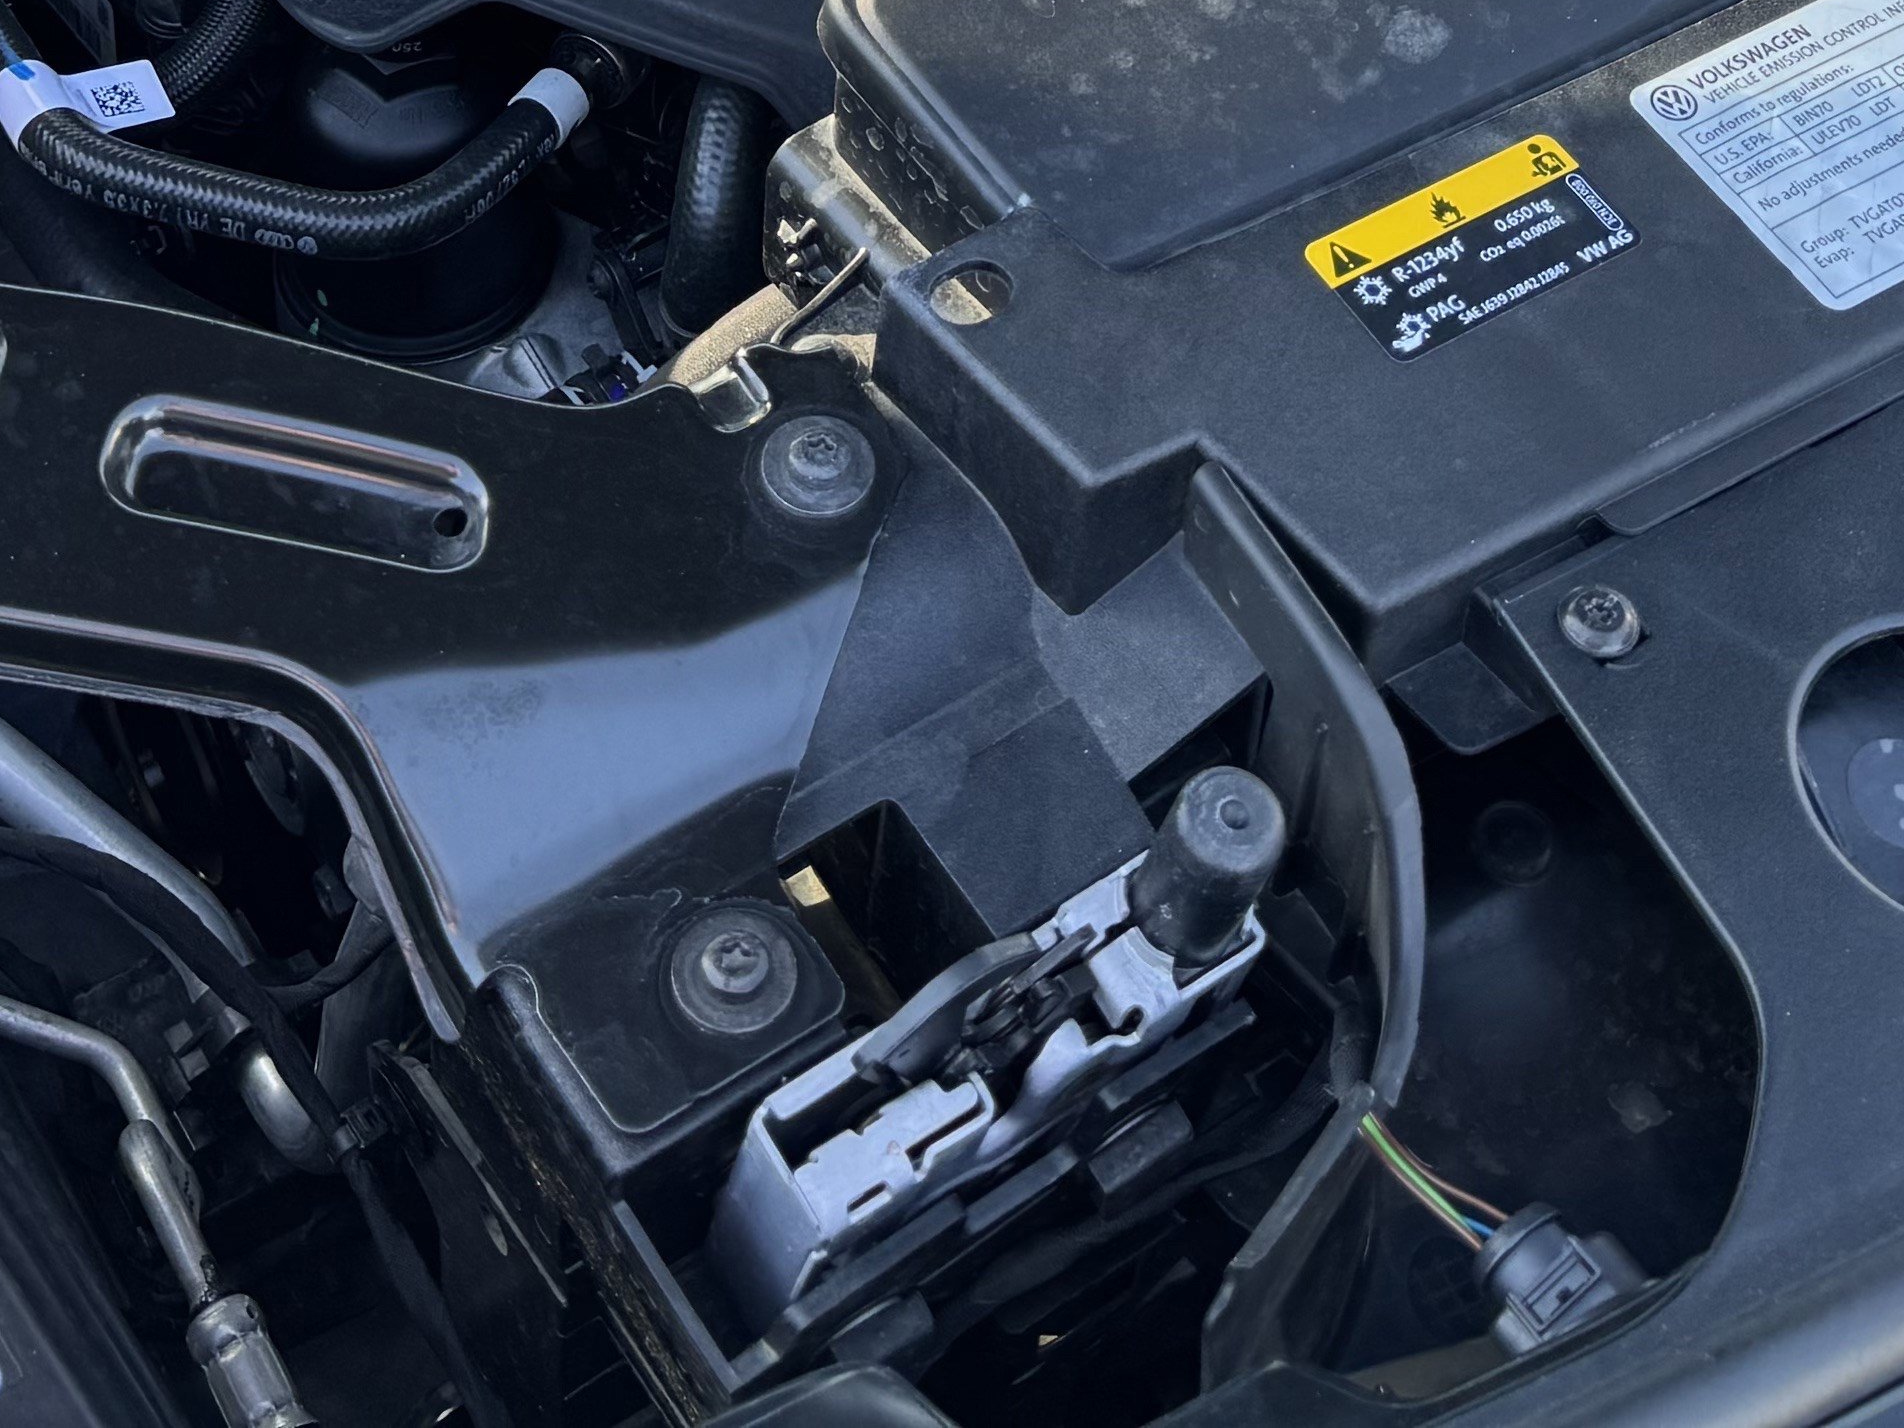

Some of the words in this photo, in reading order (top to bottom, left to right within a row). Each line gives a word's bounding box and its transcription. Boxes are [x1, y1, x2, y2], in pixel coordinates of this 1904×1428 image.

[1686, 23, 1812, 90] VOLKSWAGEN
[1702, 70, 1761, 105] VEHICLE
[1757, 40, 1825, 78] EMISSION
[1822, 12, 1886, 47] CONTROL
[1850, 75, 1887, 98] LDT2
[1694, 107, 1761, 145] Conforms
[1776, 64, 1855, 107] regulations:
[1792, 100, 1834, 127] BIN70
[1868, 96, 1896, 117] LDT
[1810, 114, 1862, 145] ULEV70
[1713, 146, 1745, 166] U.S.
[1740, 132, 1775, 152] EPA:
[1732, 146, 1804, 184] California:
[1757, 196, 1781, 212] No
[1780, 153, 1864, 201] adjustments
[1493, 205, 1534, 232] 0.650
[1529, 198, 1556, 214] kg
[1576, 240, 1608, 263] VW
[1607, 228, 1634, 250] AG
[1800, 227, 1850, 254] Group:
[1391, 235, 1465, 283] R-1234yf
[1813, 246, 1855, 269] Evap:
[1408, 277, 1437, 298] GWP
[1425, 294, 1466, 323] PAG
[1457, 305, 1484, 325] SAE
[1480, 292, 1509, 314] J639
